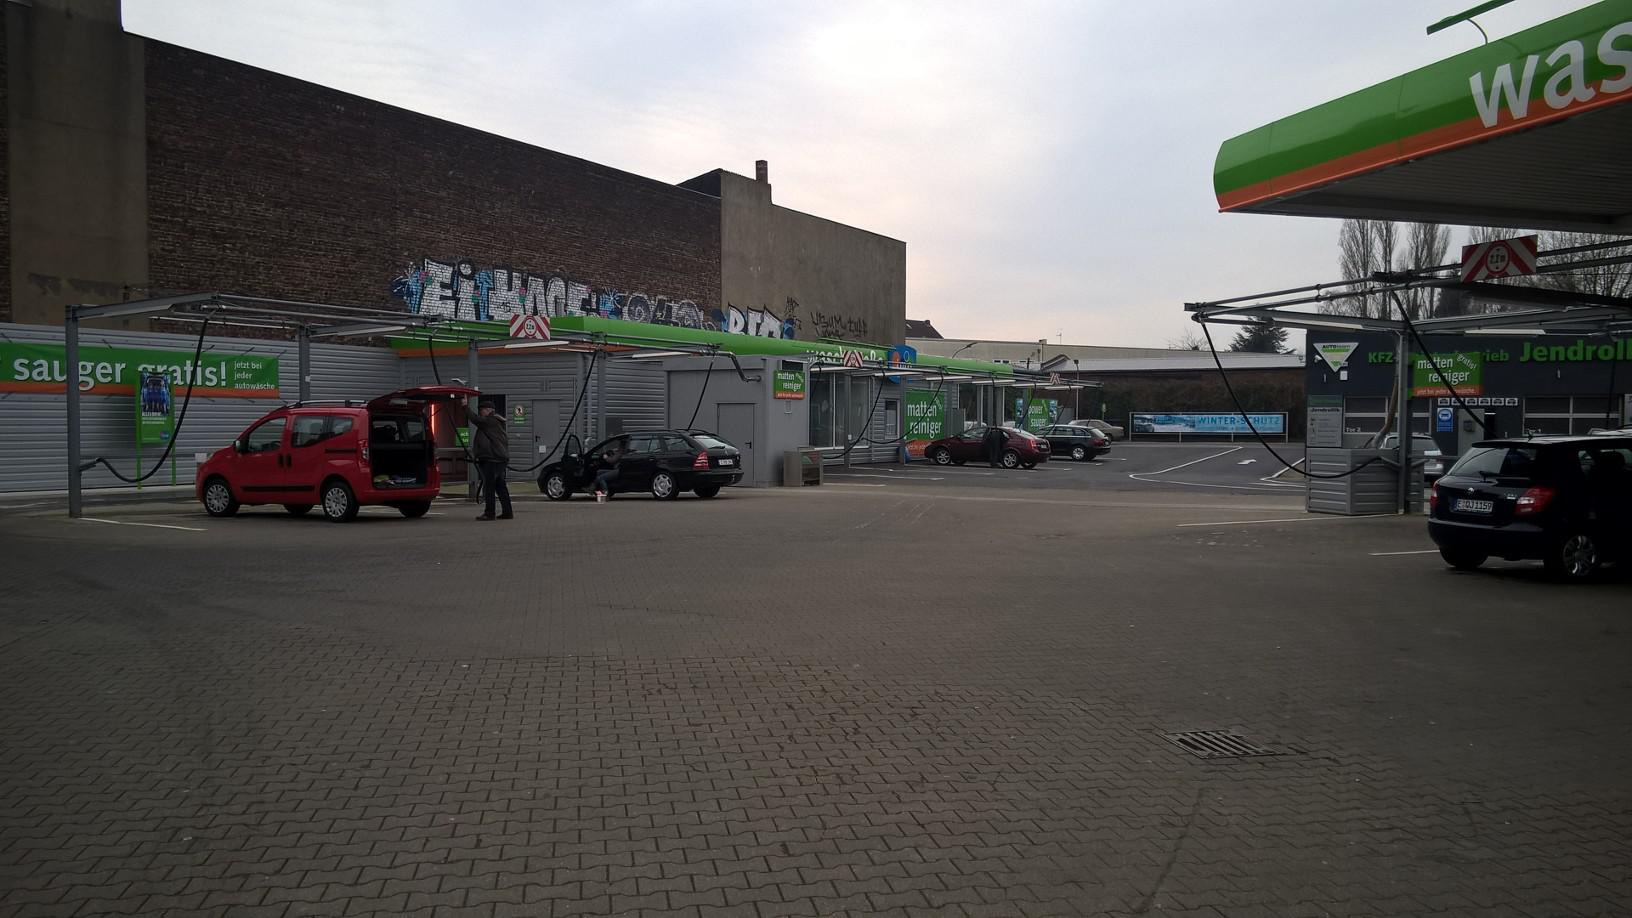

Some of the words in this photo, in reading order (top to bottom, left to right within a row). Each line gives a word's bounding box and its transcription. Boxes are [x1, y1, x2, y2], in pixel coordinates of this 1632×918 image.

[1469, 21, 1632, 128] was
[234, 361, 250, 369] jetzt
[251, 361, 263, 370] bei
[1417, 357, 1454, 369] matten
[13, 358, 126, 391] sauger
[137, 359, 227, 386] atis!
[234, 371, 253, 380] jeder
[907, 401, 937, 417] matten
[910, 418, 942, 438] reiniger
